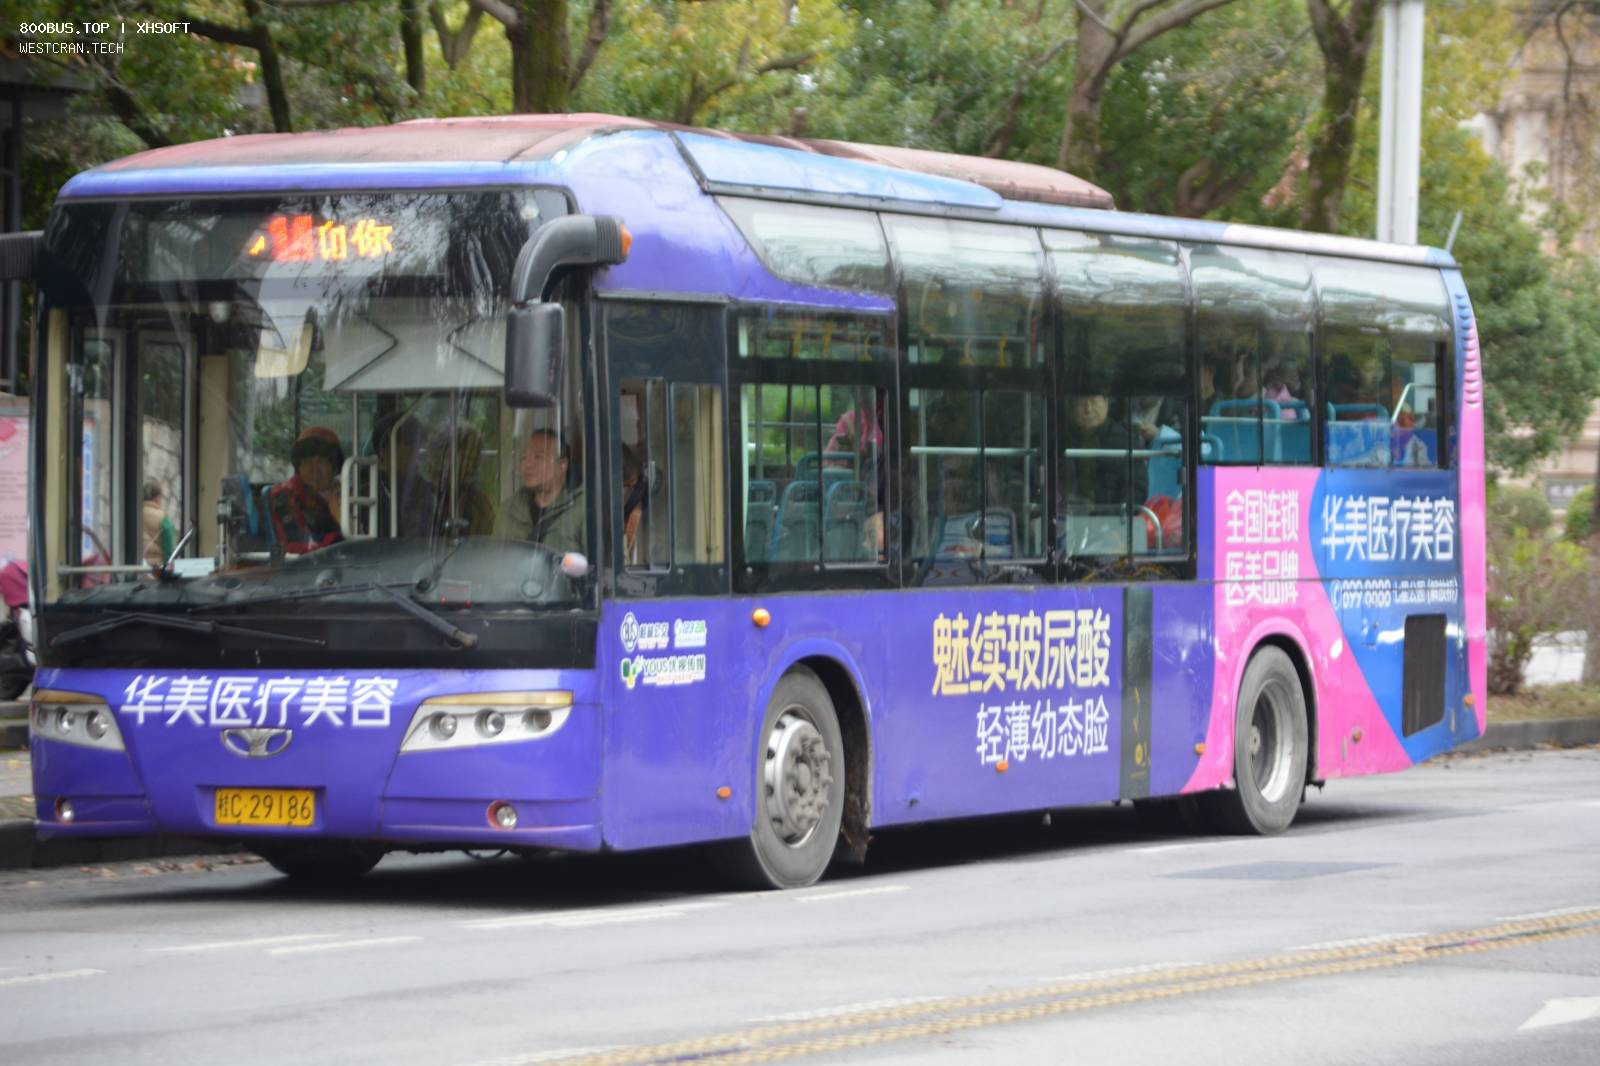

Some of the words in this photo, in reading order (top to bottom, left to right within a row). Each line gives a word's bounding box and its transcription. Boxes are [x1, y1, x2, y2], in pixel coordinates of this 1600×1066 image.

[1226, 489, 1299, 543] 全国连锁
[1322, 494, 1455, 561] 华美医疗美容
[1225, 550, 1299, 606] 医美品牌
[932, 607, 1111, 696] 魅续玻尿酸
[120, 674, 399, 727] 华美医疗美容
[976, 694, 1109, 765] 轻薄幼态脸
